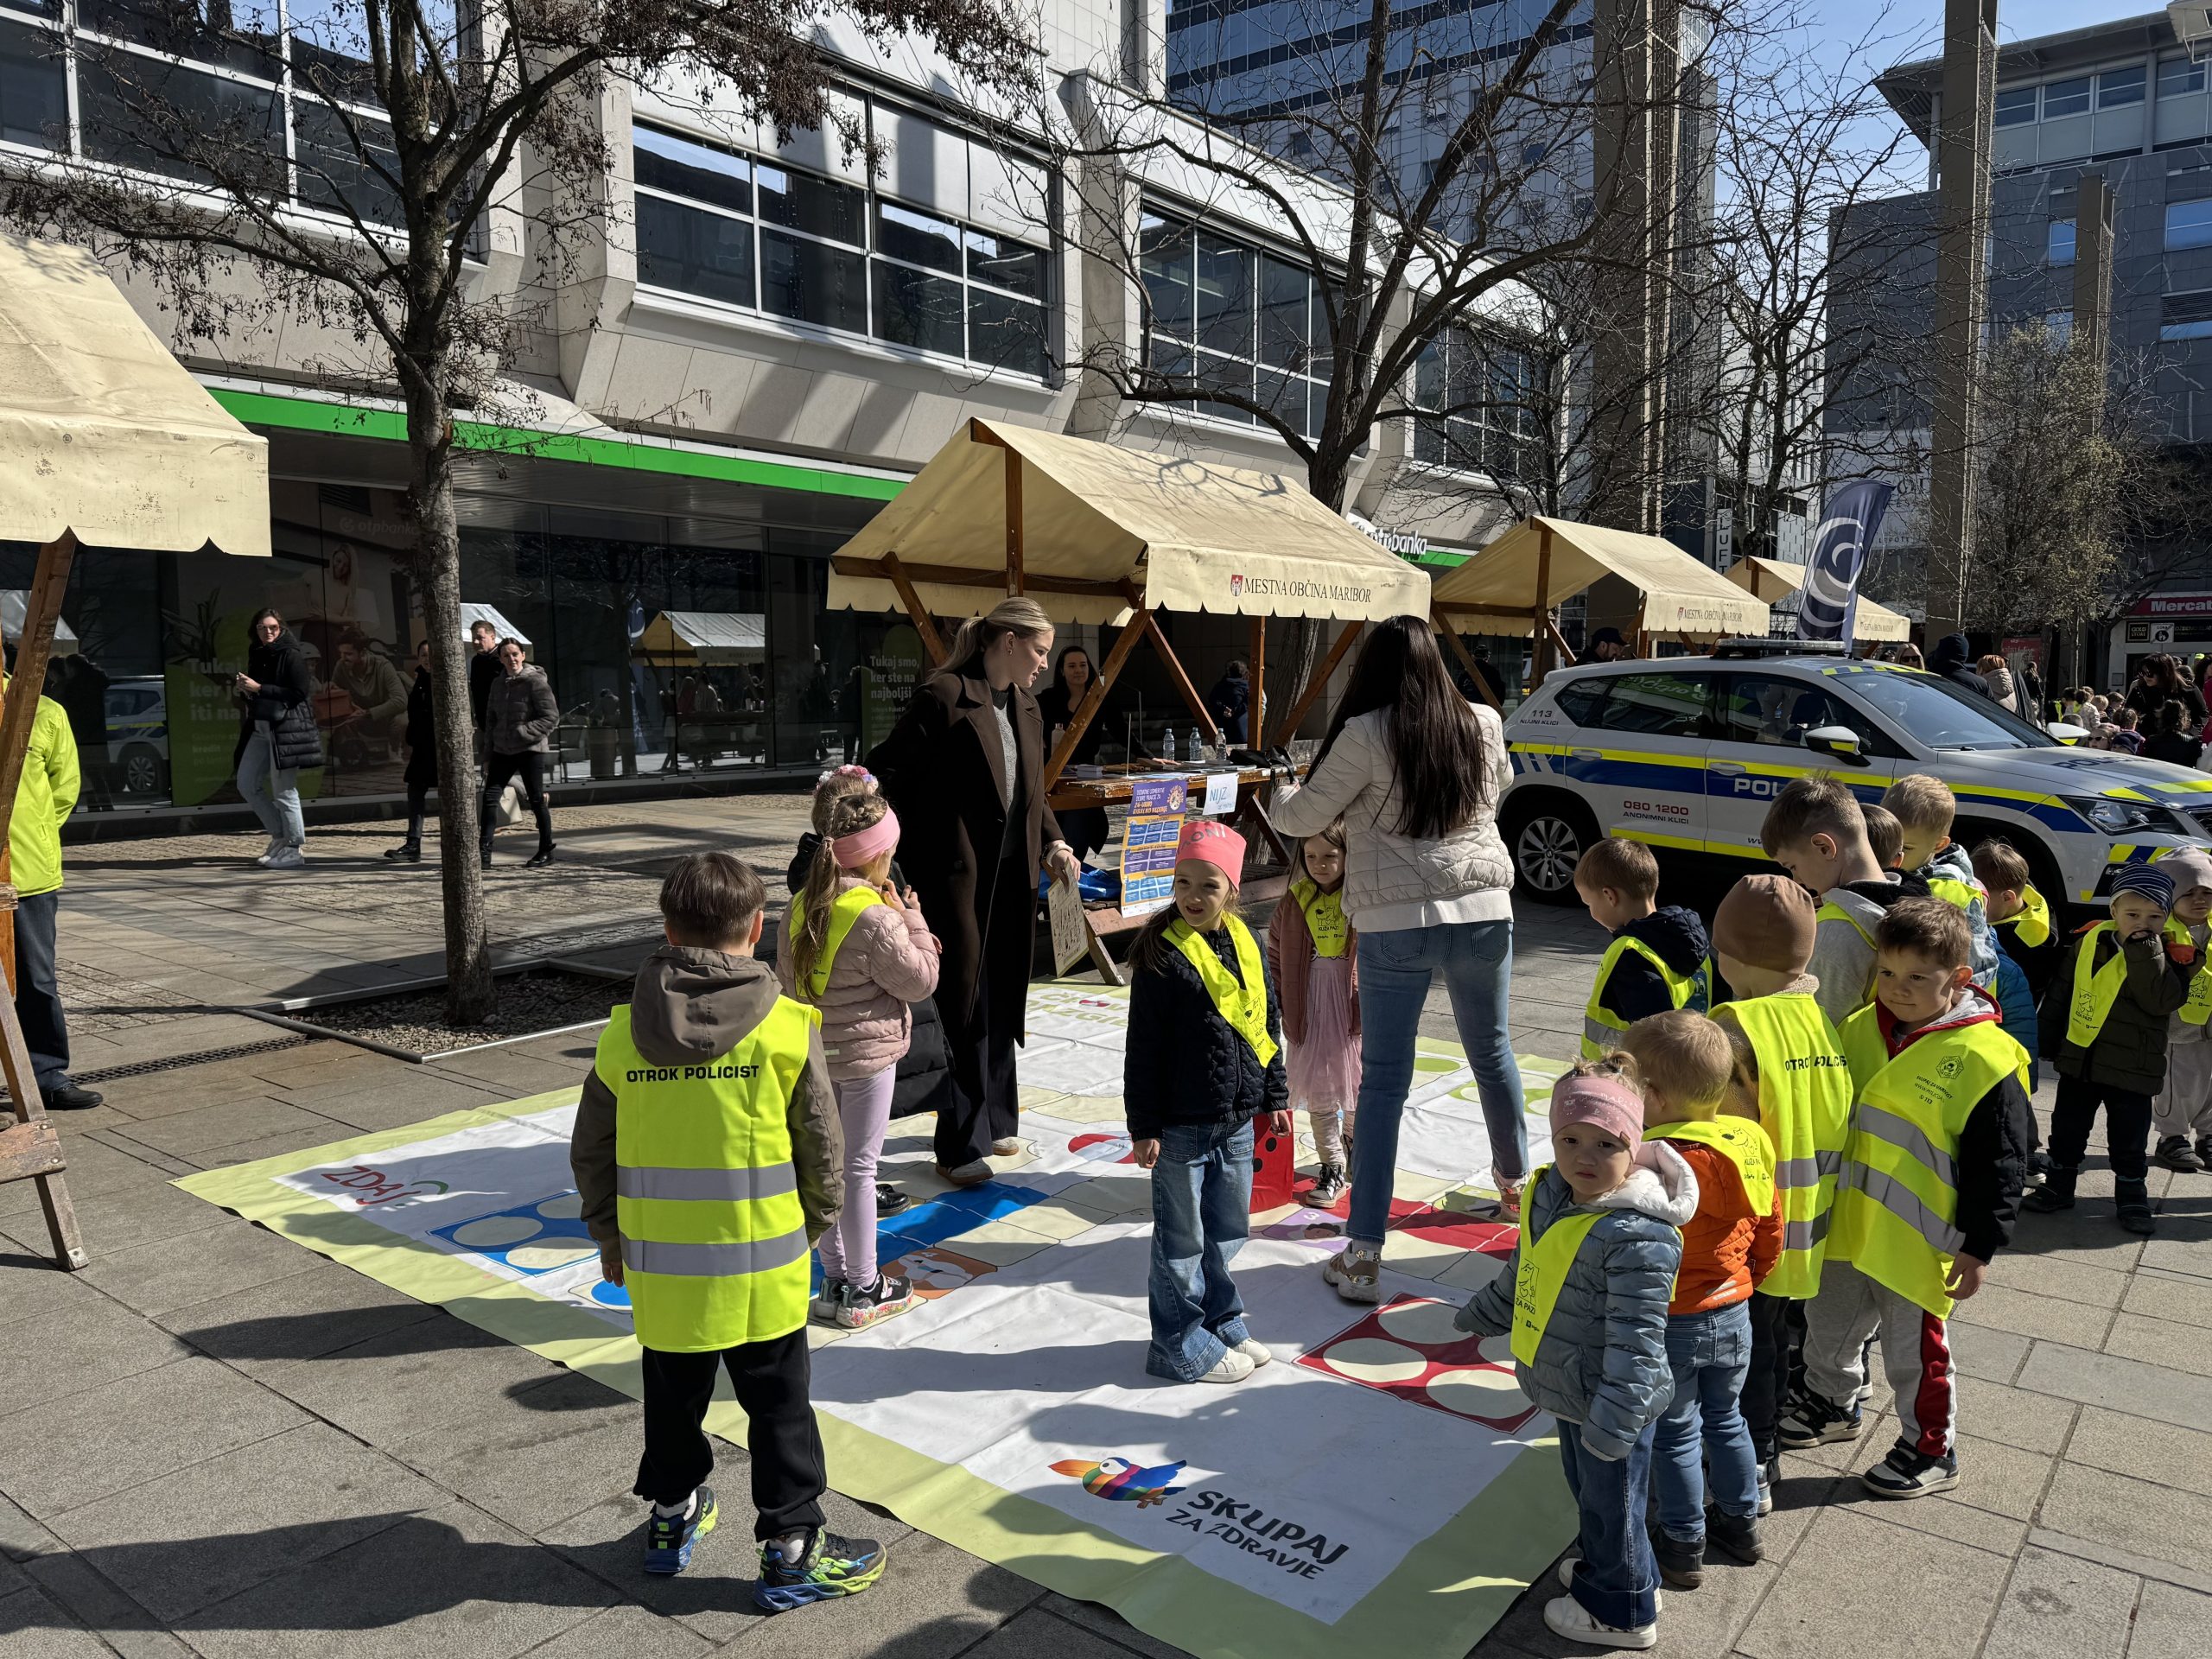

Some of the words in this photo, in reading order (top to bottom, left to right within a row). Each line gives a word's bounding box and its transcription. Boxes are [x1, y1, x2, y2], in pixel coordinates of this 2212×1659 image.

[1244, 578, 1287, 596] MESTNA
[1289, 579, 1328, 599] OBČINA
[1329, 586, 1372, 603] MARIBOR
[869, 655, 896, 671] Tukaj
[898, 658, 920, 670] smo,
[870, 670, 887, 683] ker
[887, 671, 902, 683] ste
[904, 673, 916, 683] na
[188, 681, 219, 698] ker
[871, 686, 912, 702] najboljši
[190, 703, 213, 721] iti
[218, 708, 241, 721] na
[1532, 709, 1553, 718] 113
[1210, 787, 1228, 804] NIJZ
[1624, 800, 1650, 811] 080
[1655, 804, 1689, 816] 1200
[1623, 811, 1667, 823] ANONIMNI
[1668, 816, 1689, 824] KLICI
[1784, 1056, 1811, 1071] OTRO
[626, 1067, 679, 1083] OTROK
[684, 1065, 760, 1080] POLICIST
[1304, 1211, 1320, 1221] 3
[1186, 1491, 1350, 1565] SKUPAJ
[1166, 1508, 1203, 1533] ZA
[1204, 1522, 1325, 1580] ZDRAVJE
